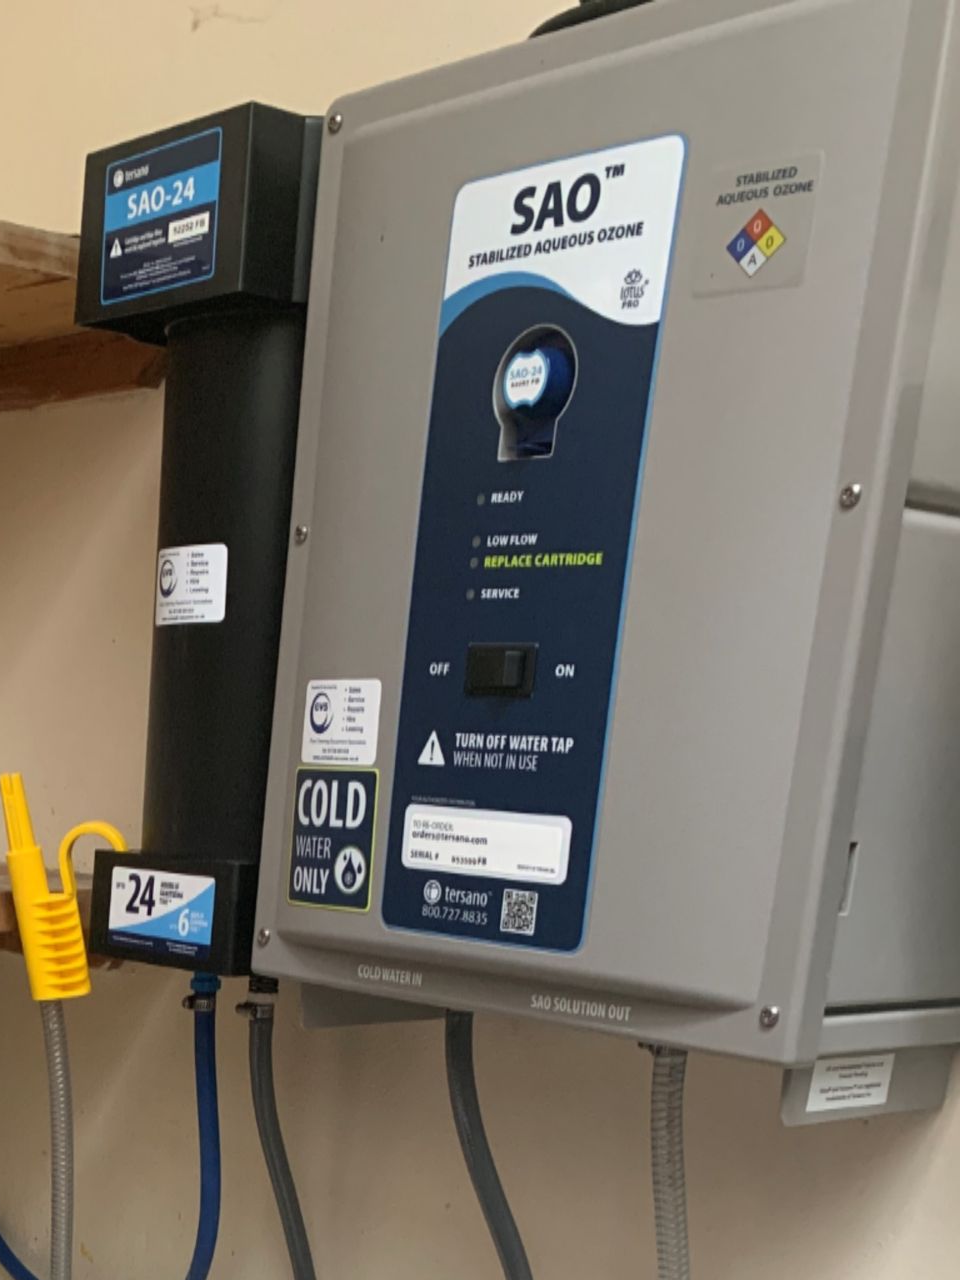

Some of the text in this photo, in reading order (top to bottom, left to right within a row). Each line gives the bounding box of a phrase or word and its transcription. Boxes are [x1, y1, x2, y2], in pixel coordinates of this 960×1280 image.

[125, 164, 149, 183] tersano
[736, 166, 798, 187] STABILIZED
[127, 177, 195, 220] SAO-24
[716, 180, 814, 207] AQUEOUS OZONE
[753, 219, 763, 233] 0
[468, 221, 645, 269] STABILIZED AQUEOUS OZONE
[747, 253, 758, 267] A
[491, 490, 524, 503] READY
[487, 533, 538, 547] LOW FLOW
[484, 552, 603, 568] REPLACE CARTRIDGE
[480, 587, 520, 599] SERVICE
[429, 662, 575, 678] OFF ON
[455, 733, 574, 754] TURN OFF WATER TAP
[453, 751, 539, 772] WHEN NOT IN USE
[297, 779, 367, 829] COLD
[295, 834, 331, 859] WATER
[412, 830, 488, 846] orders@tersano.com
[410, 850, 434, 861] SERIAL
[293, 865, 330, 895] ONLY
[126, 872, 156, 916] 24
[445, 886, 489, 907] tersano
[178, 908, 190, 937] 6
[421, 906, 489, 925] 800.727.8835
[357, 964, 423, 987] COLD WATER IN
[530, 994, 632, 1022] SAO SOLUTION OUT
